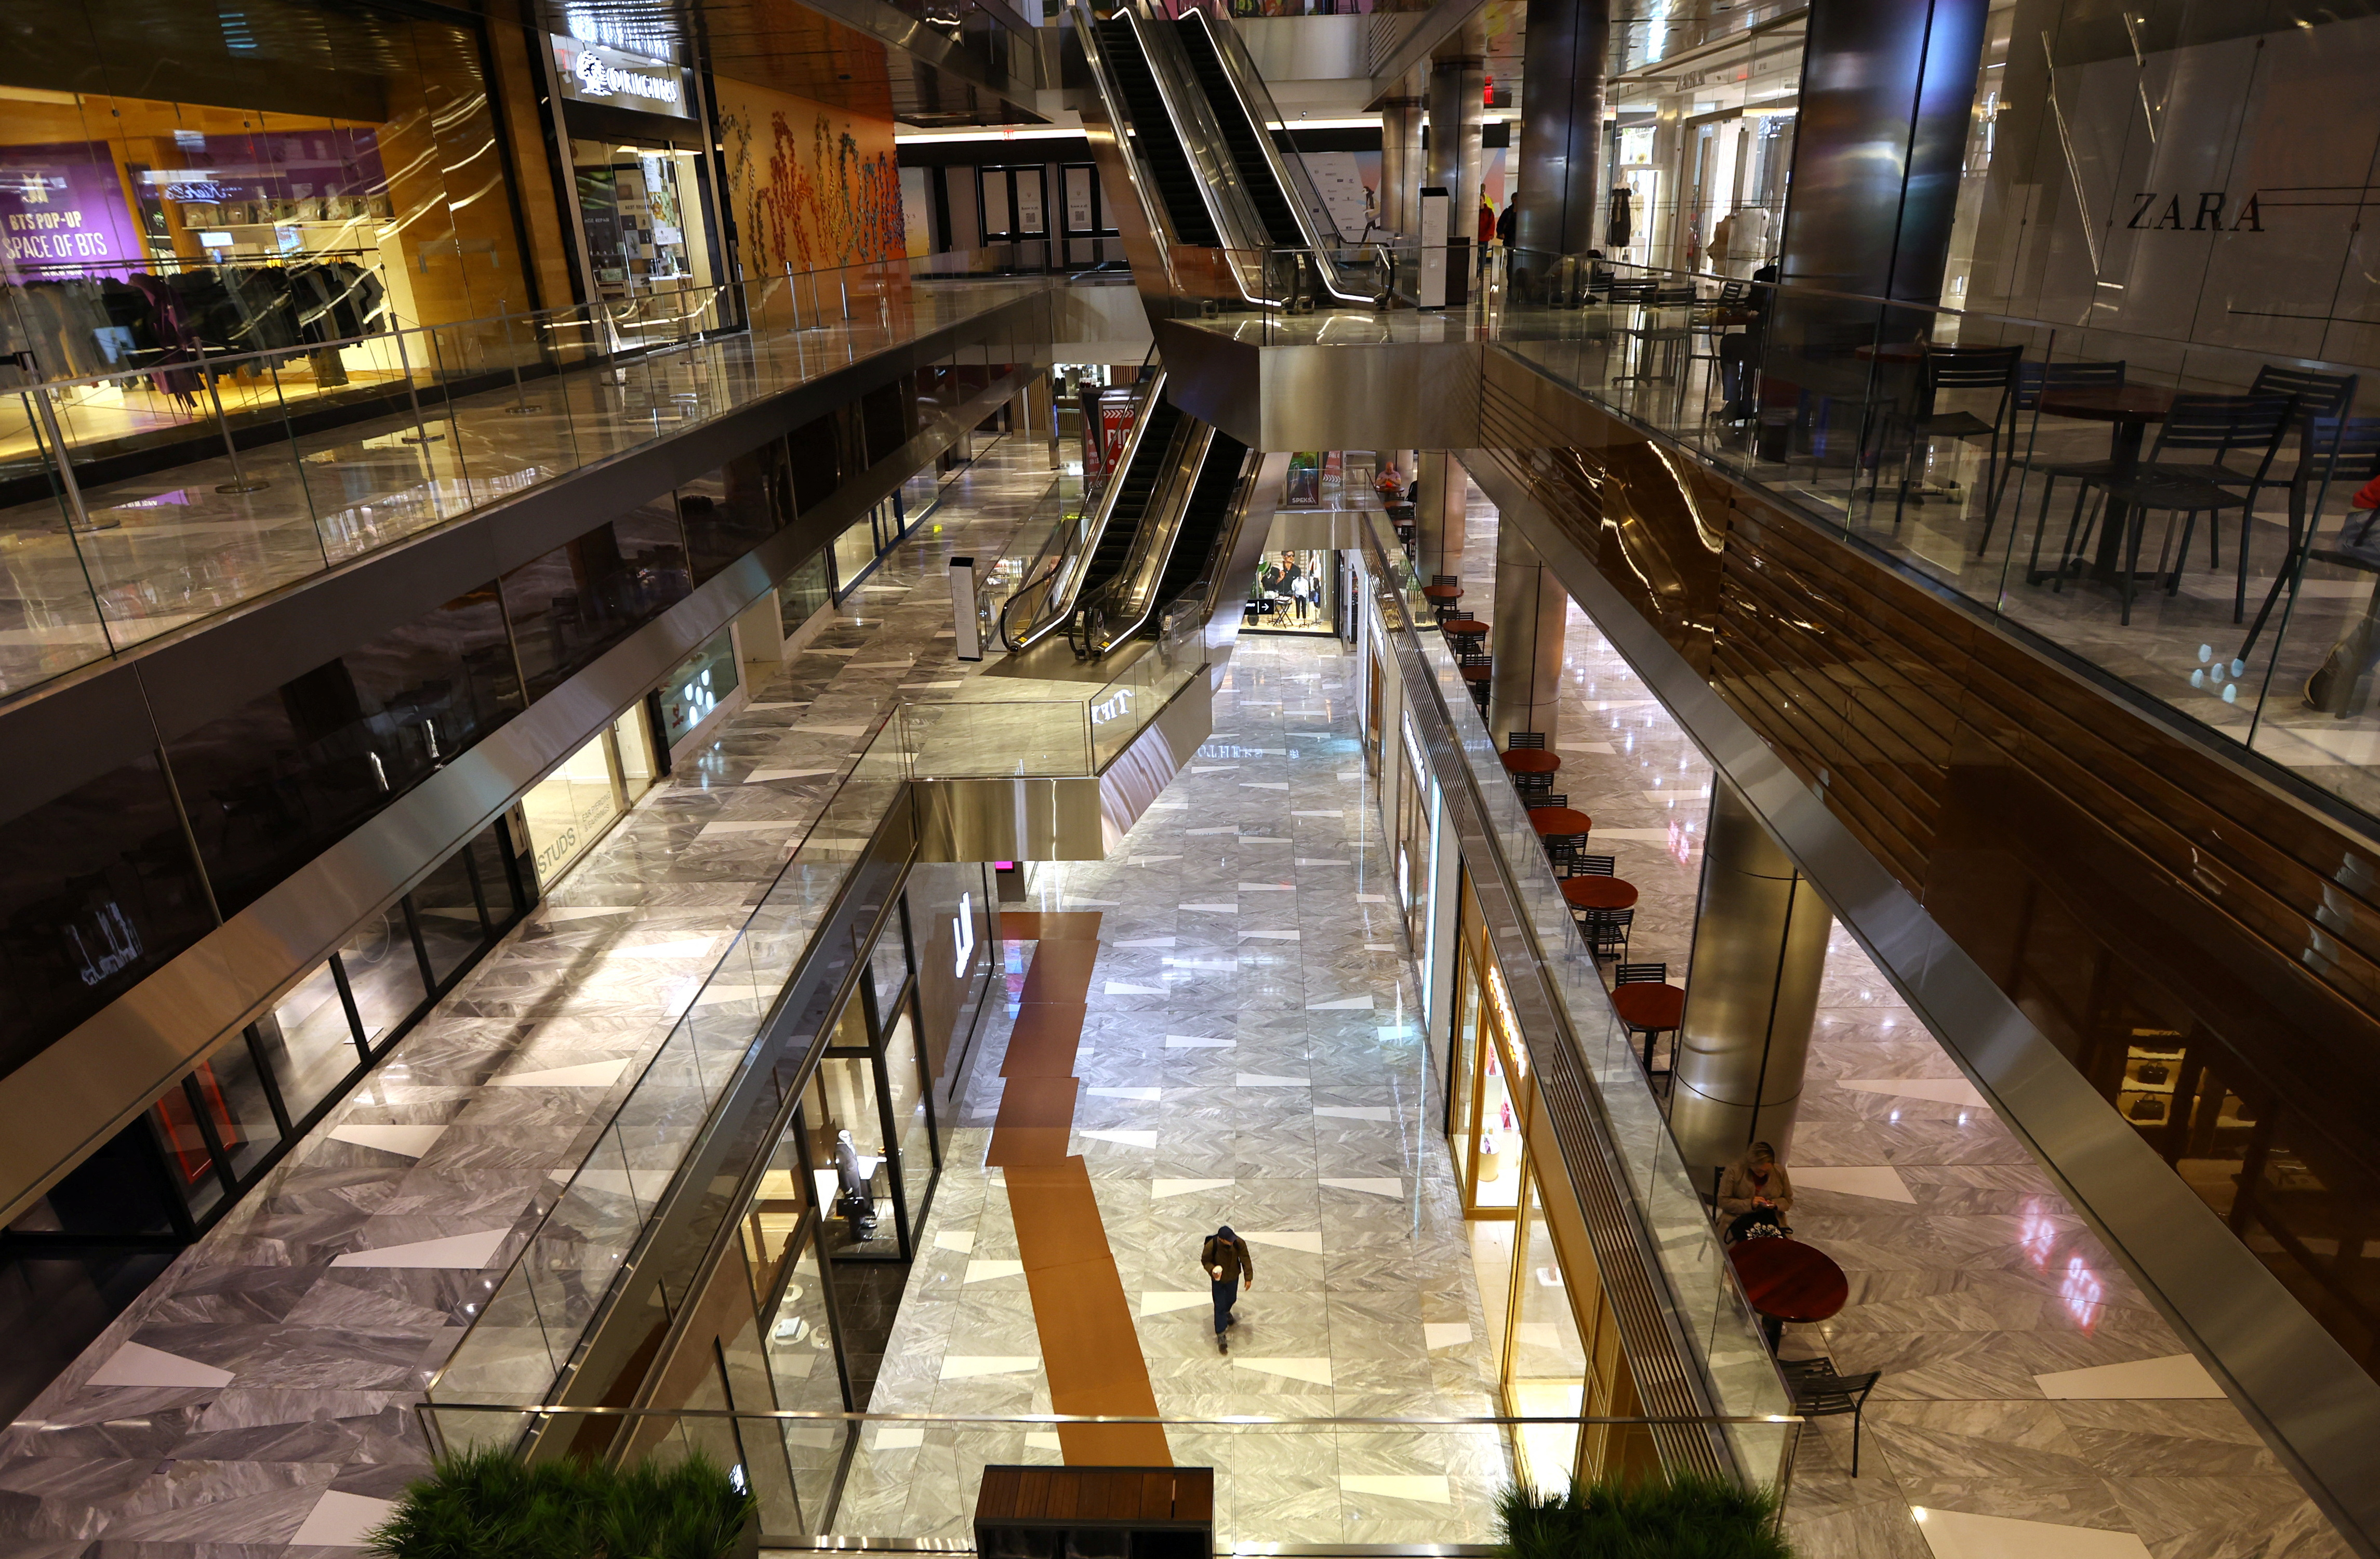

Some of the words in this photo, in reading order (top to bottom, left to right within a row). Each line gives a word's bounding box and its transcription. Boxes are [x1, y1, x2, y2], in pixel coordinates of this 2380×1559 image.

[606, 67, 676, 102] ORIGINS
[1676, 70, 1706, 93] ZARA
[8, 213, 36, 231] BTS
[36, 210, 82, 230] POP-UP
[2127, 192, 2265, 232] ZARA
[2, 235, 53, 260] SPACE
[52, 234, 73, 257] OF
[74, 232, 108, 257] BTS
[537, 827, 575, 874] STUDS
